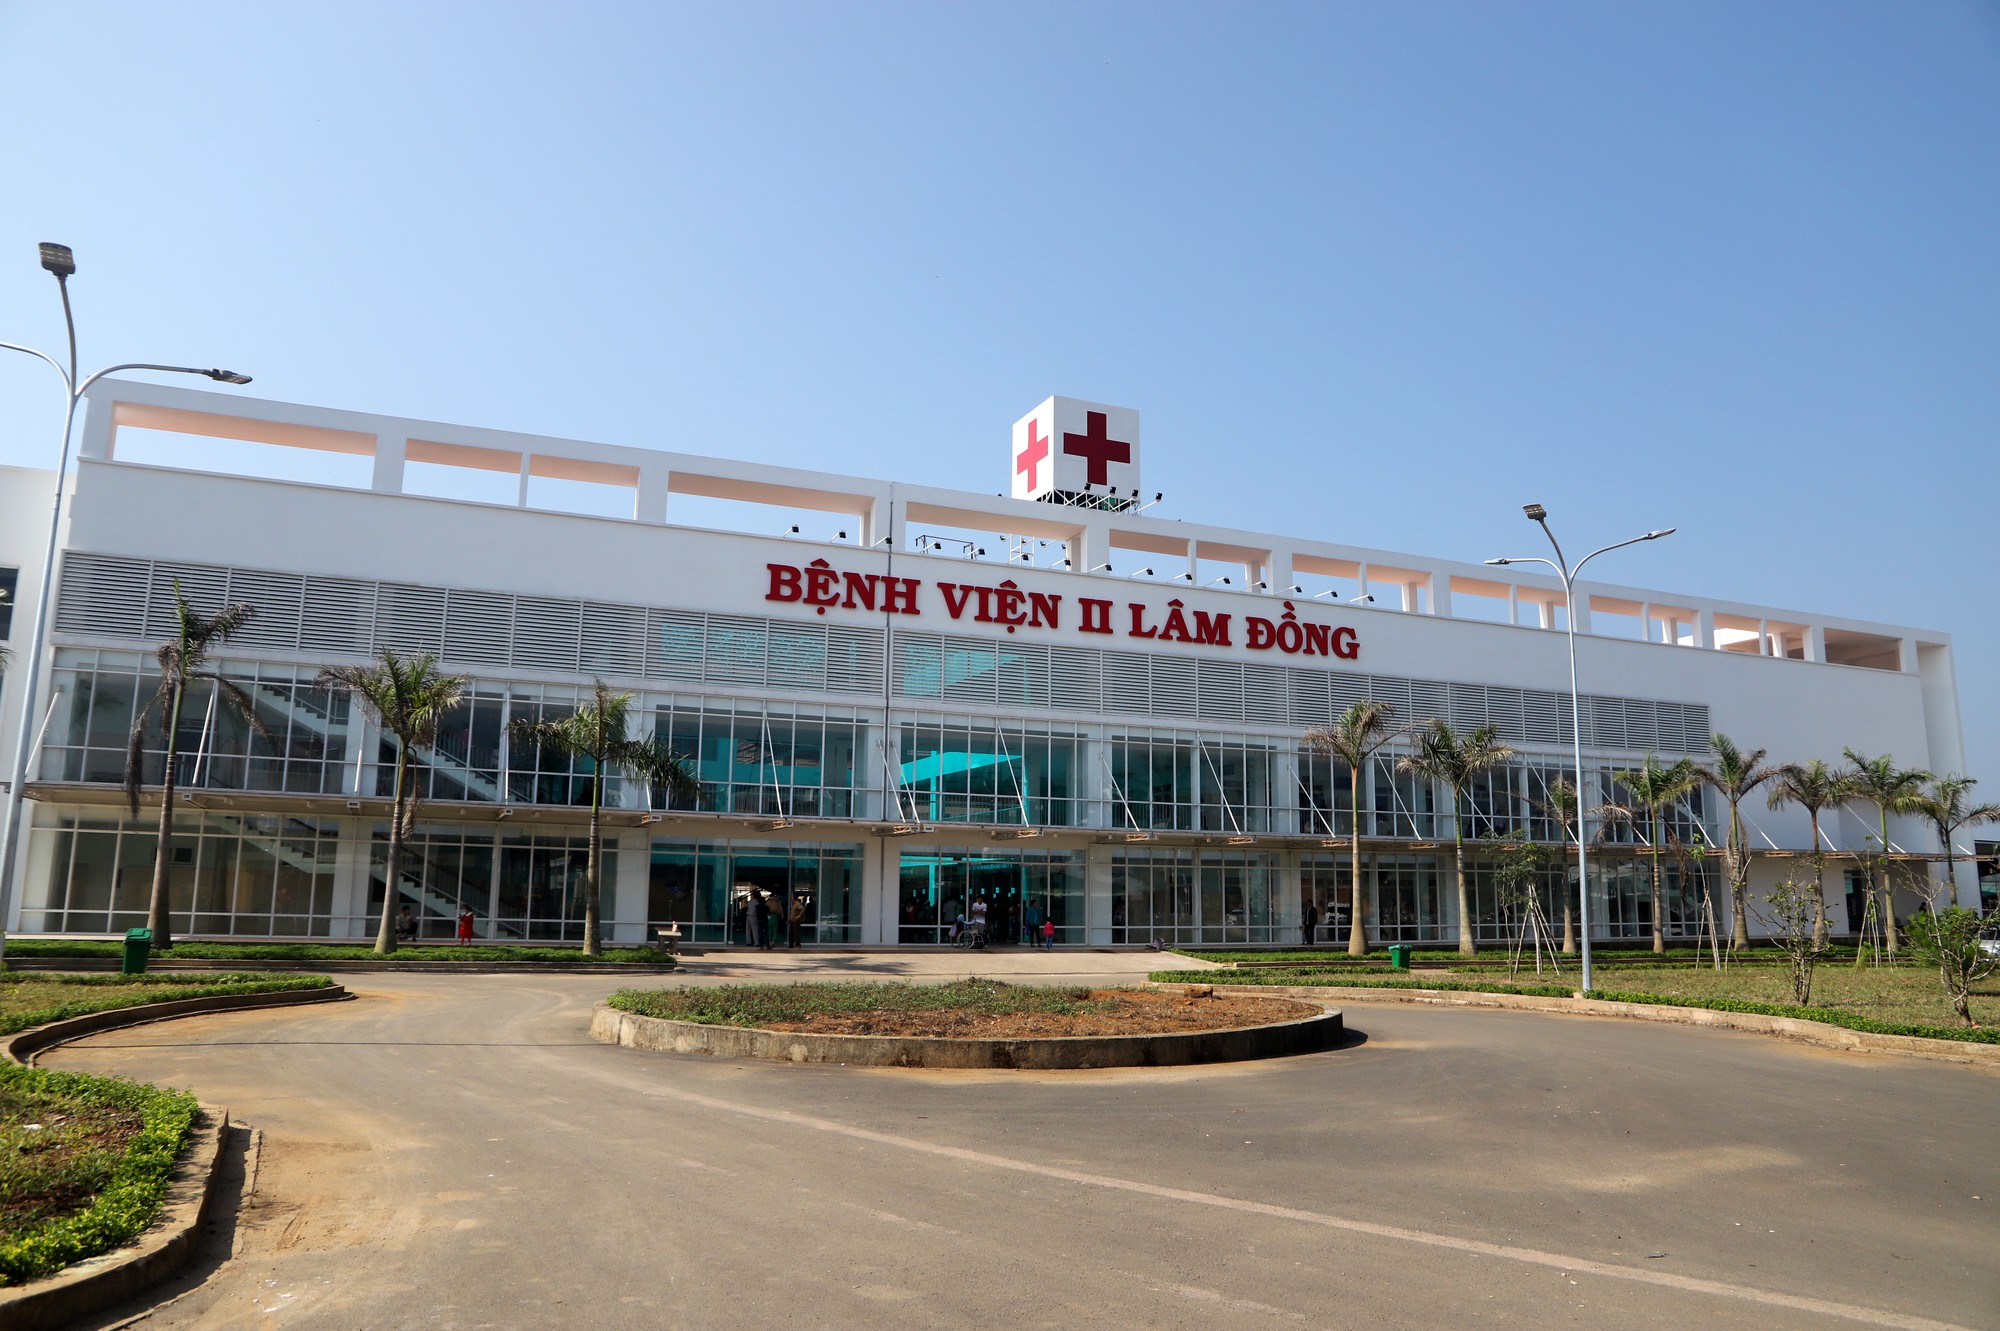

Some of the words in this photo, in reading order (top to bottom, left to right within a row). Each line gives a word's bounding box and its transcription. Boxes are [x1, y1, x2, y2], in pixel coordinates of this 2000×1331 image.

[765, 558, 921, 615] BỆNH
[937, 580, 1062, 633] VIỆN
[1078, 597, 1114, 635] II
[1128, 599, 1232, 648] LÂM
[1245, 601, 1360, 660] ĐỒNG
